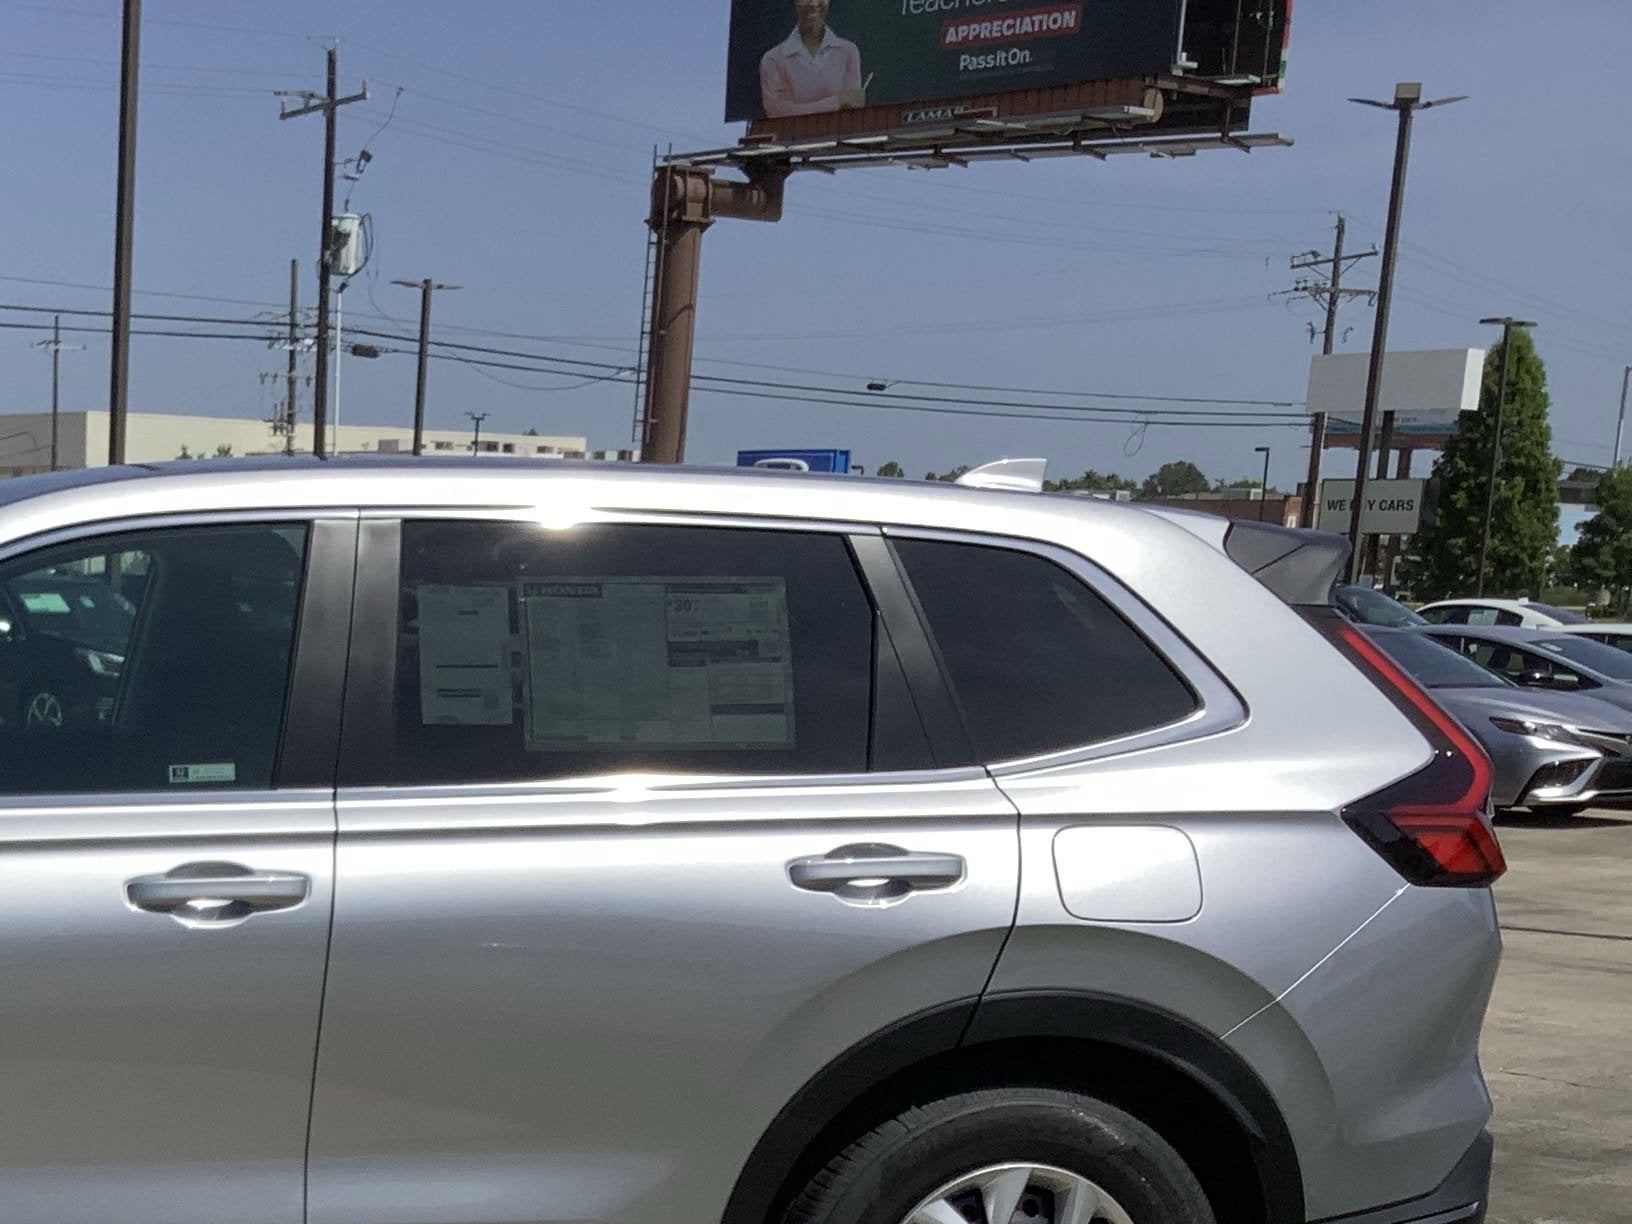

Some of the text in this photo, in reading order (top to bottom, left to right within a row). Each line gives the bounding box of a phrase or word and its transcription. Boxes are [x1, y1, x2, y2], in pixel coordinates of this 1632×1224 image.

[945, 10, 1077, 44] APPRECIATION
[1327, 499, 1346, 511] WE
[1378, 499, 1414, 511] CARS
